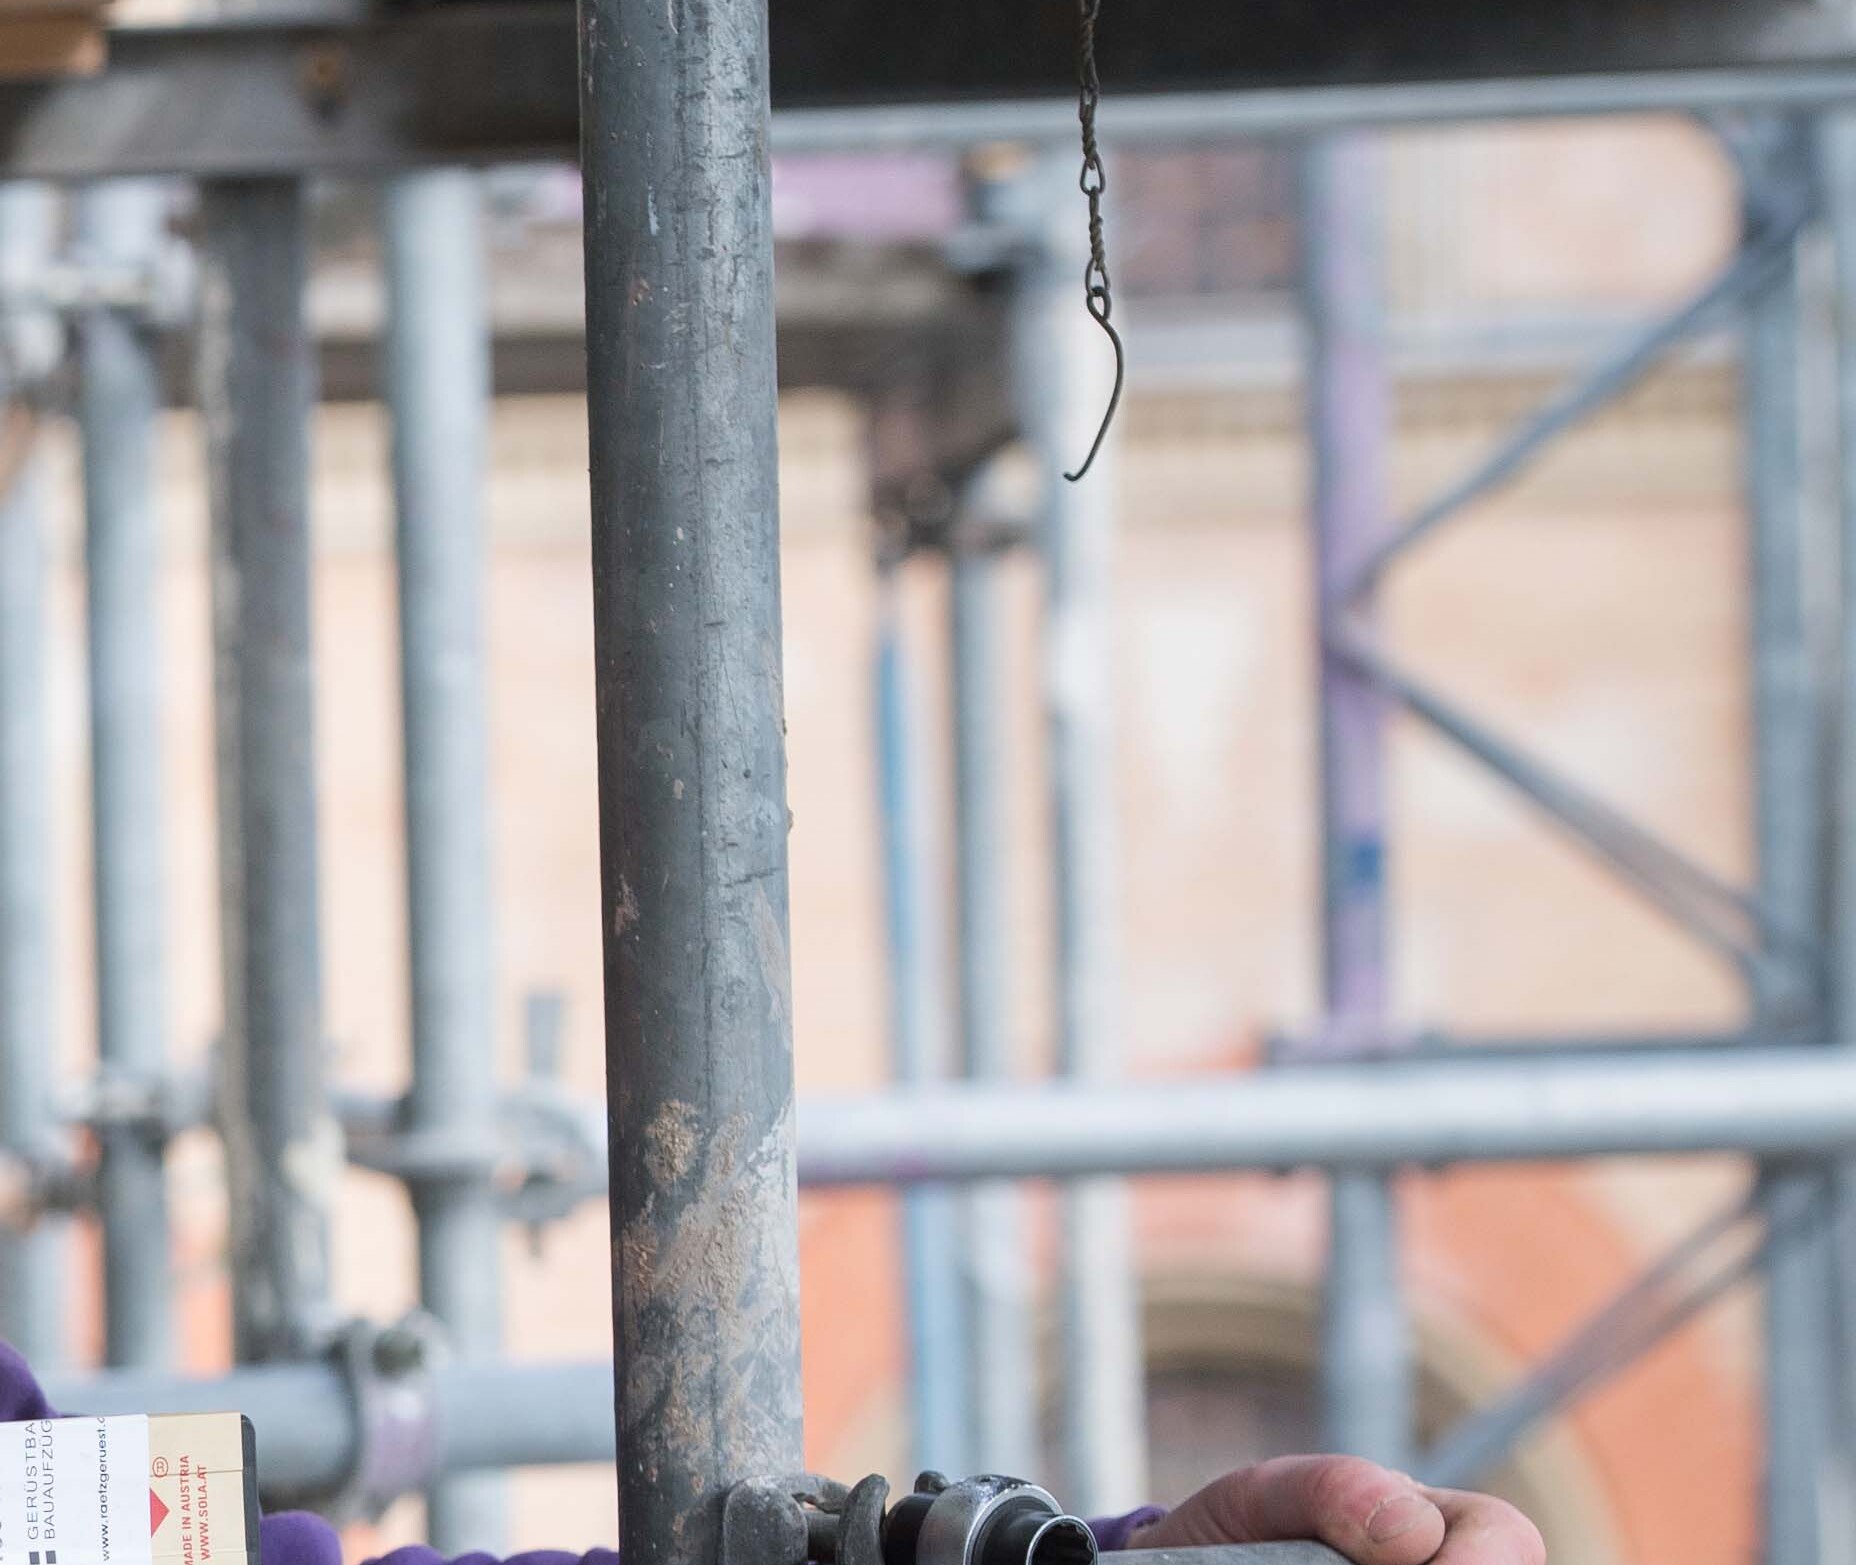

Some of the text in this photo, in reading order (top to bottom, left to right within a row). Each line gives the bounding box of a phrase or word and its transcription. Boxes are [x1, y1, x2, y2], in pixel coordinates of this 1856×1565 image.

[24, 1422, 39, 1540] GERÜSTBA
[179, 1454, 191, 1512] AUSTRIA
[197, 1464, 212, 1561] WWW.SOLA.AT
[182, 1516, 192, 1530] IN
